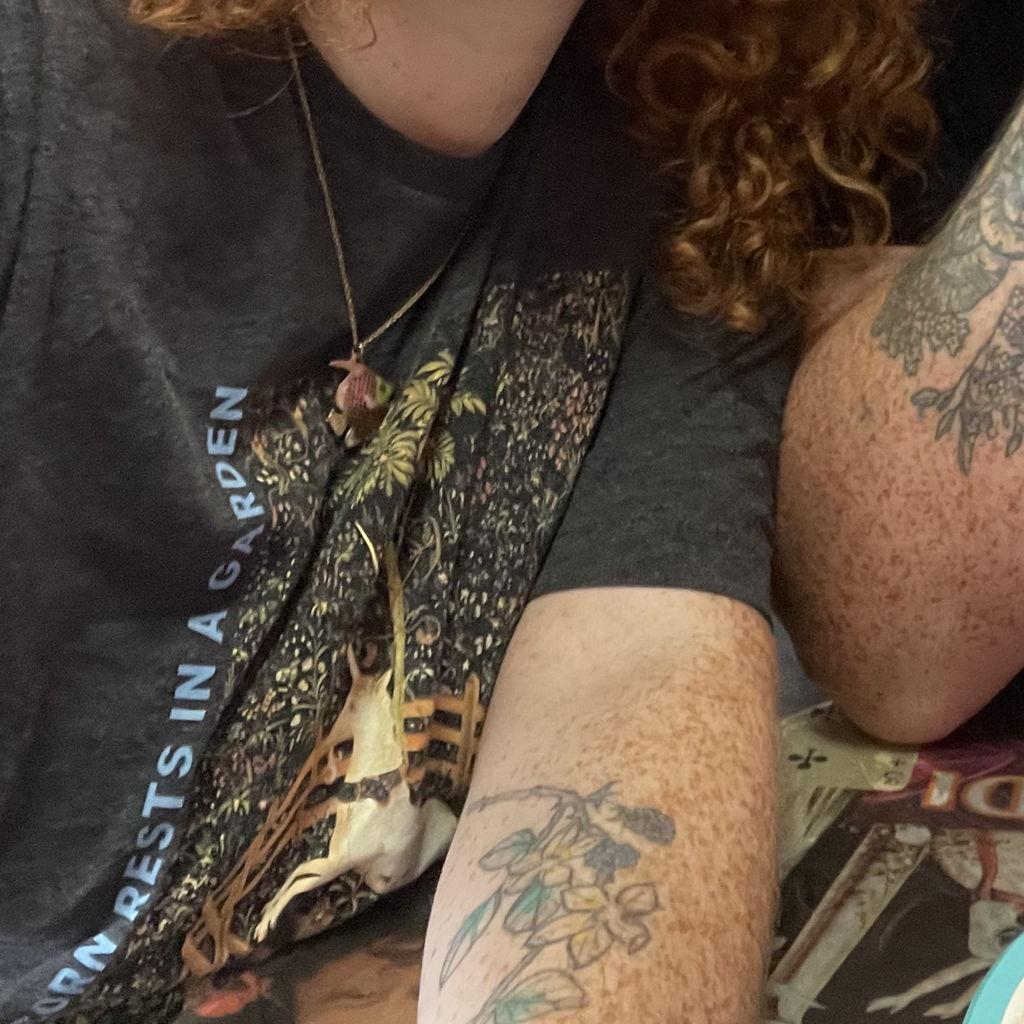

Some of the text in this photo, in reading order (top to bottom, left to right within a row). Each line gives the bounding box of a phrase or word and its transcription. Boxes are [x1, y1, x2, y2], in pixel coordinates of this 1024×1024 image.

[208, 386, 266, 591] GARDEN
[187, 609, 228, 644] A
[169, 663, 216, 722] IN
[114, 743, 194, 922] RESTS
